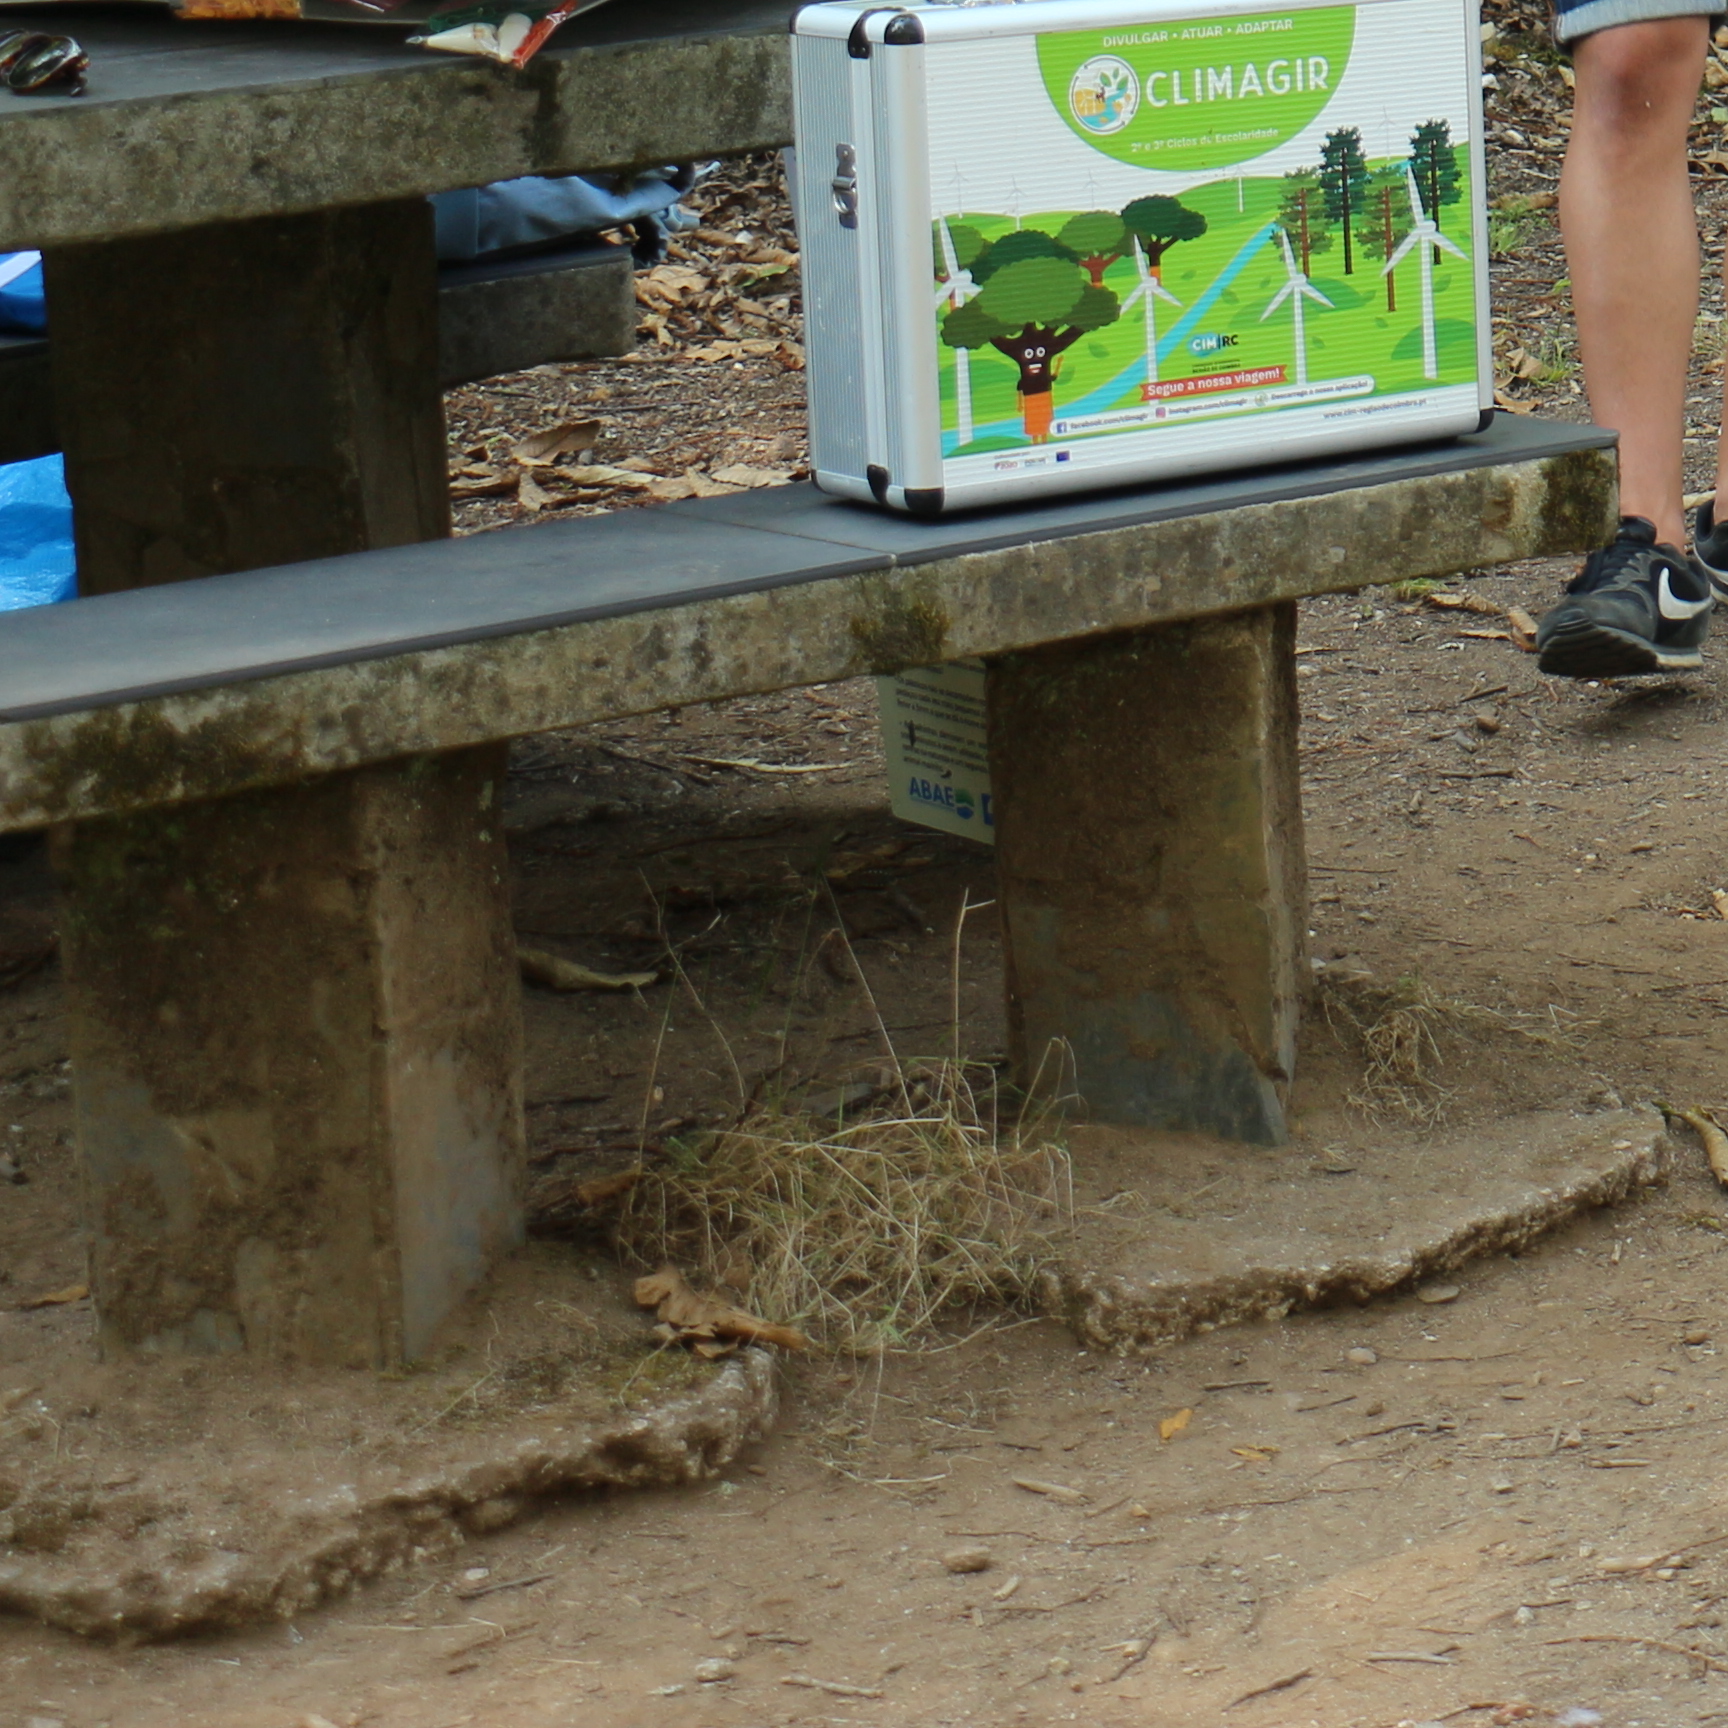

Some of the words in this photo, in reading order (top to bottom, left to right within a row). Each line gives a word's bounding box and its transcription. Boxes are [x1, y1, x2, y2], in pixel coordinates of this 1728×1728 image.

[1103, 30, 1168, 47] DIVULGAR
[1181, 25, 1223, 40] ATUAR
[1235, 19, 1293, 35] ADAPTAR
[1146, 55, 1330, 108] CLIMAGIR
[1167, 137, 1198, 149] Ciclos
[1215, 128, 1279, 144] Escolaridade
[1147, 382, 1184, 398] Segue
[1187, 377, 1195, 391] a
[1198, 375, 1232, 389] nossa
[1234, 367, 1281, 388] viagem!
[909, 776, 955, 807] ABAE
